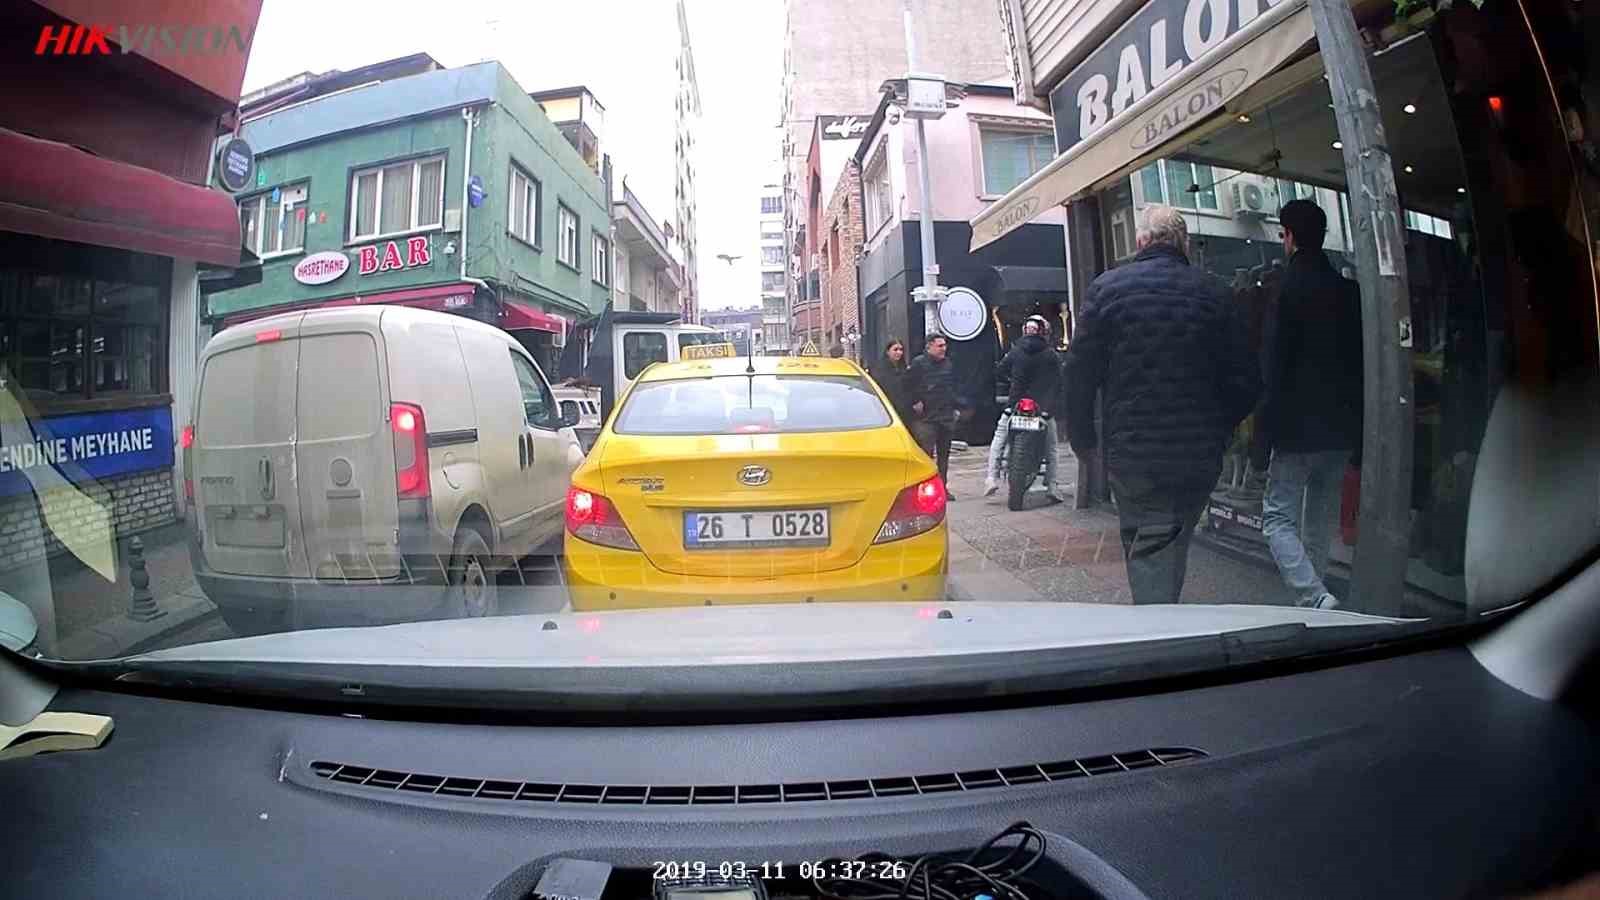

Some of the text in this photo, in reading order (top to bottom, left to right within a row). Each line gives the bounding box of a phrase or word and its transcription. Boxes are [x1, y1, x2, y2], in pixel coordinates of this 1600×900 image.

[1144, 79, 1224, 143] BALON
[359, 237, 430, 275] BAR
[71, 429, 153, 460] MEYHANE
[698, 516, 723, 538] 26
[740, 515, 753, 537] T
[772, 513, 824, 536] 0528
